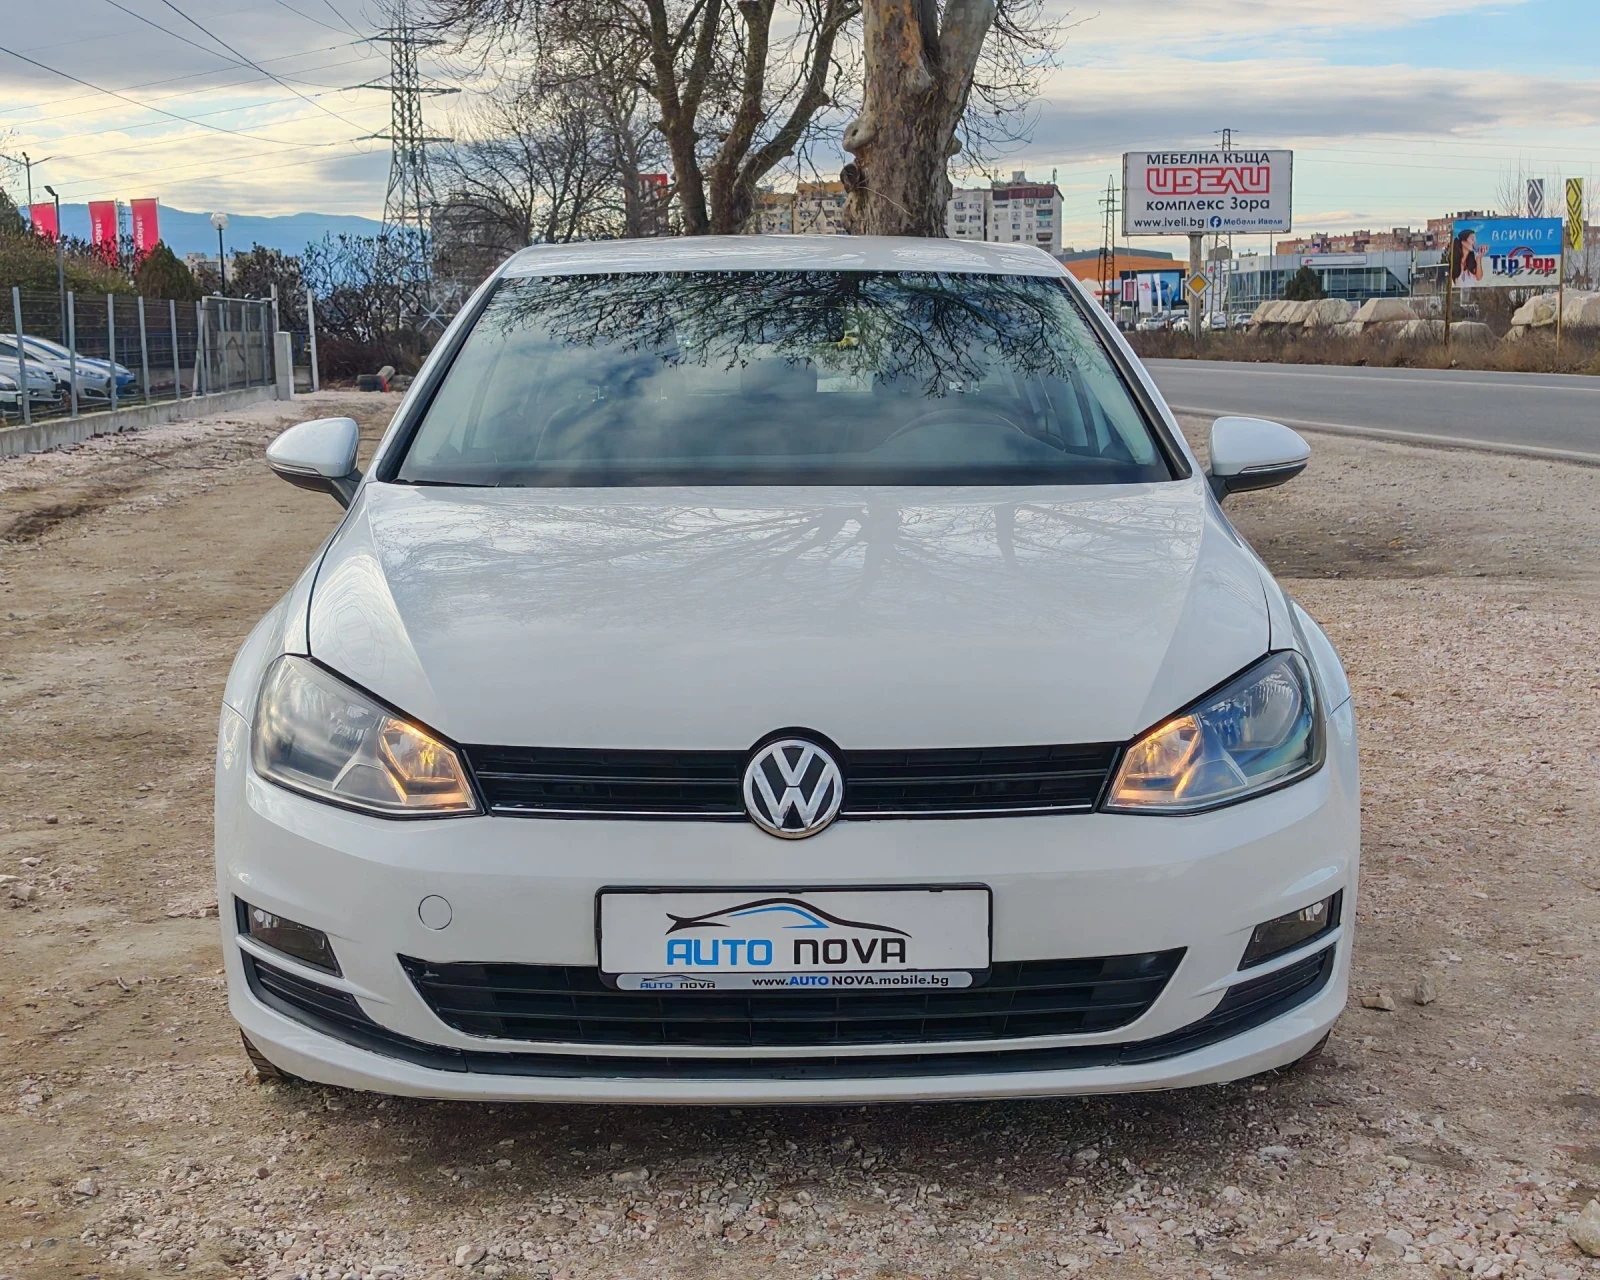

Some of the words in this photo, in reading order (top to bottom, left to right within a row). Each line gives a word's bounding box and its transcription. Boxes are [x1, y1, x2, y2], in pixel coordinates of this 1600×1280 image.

[1146, 153, 1219, 165] МЕБЕЛНА
[1223, 152, 1270, 165] КЪЩА
[1146, 166, 1270, 195] ИВЕЛИ
[1146, 199, 1225, 211] комплекс
[1230, 197, 1270, 212] Зора
[1134, 217, 1205, 228] www.iveli.bg
[1223, 218, 1256, 226] Мебели
[1258, 218, 1283, 226] Ивели
[1491, 229, 1542, 241] ВСИЧКО
[1490, 255, 1518, 275] Tip
[1523, 254, 1556, 275] Top
[666, 939, 773, 966] AUTO
[793, 938, 906, 964] NOVA
